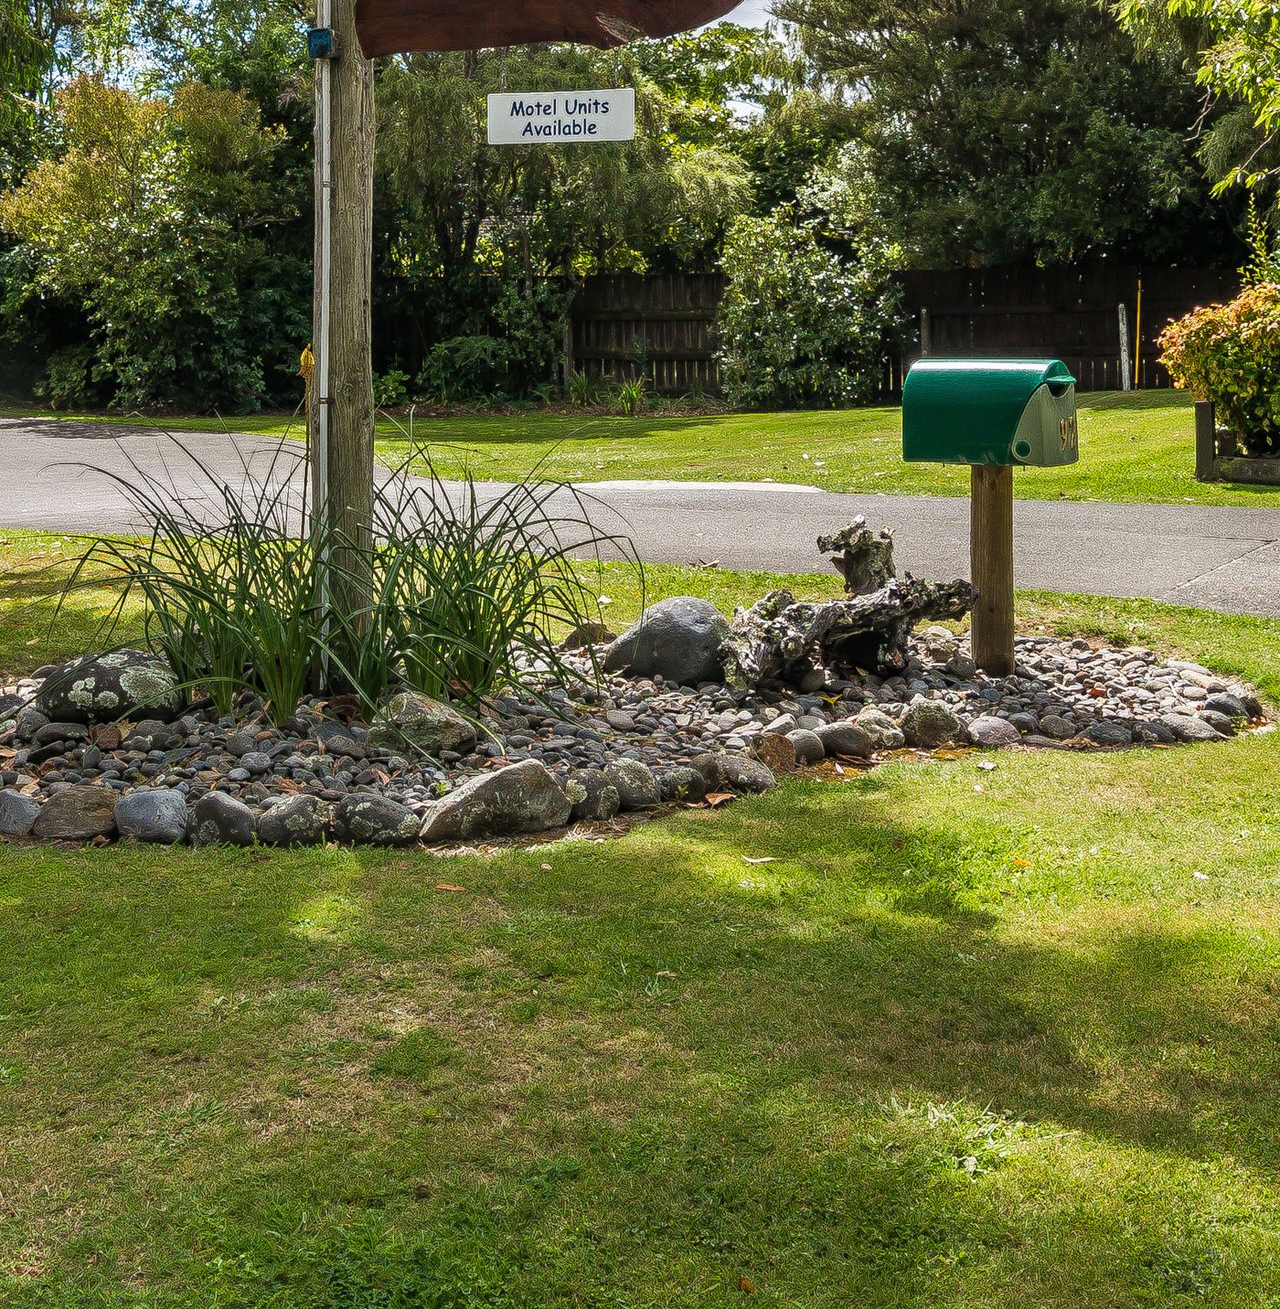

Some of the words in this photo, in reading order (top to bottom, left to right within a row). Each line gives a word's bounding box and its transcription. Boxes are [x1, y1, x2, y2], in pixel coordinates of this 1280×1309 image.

[510, 98, 557, 117] Motel
[565, 98, 610, 116] Units
[521, 118, 598, 137] Available
